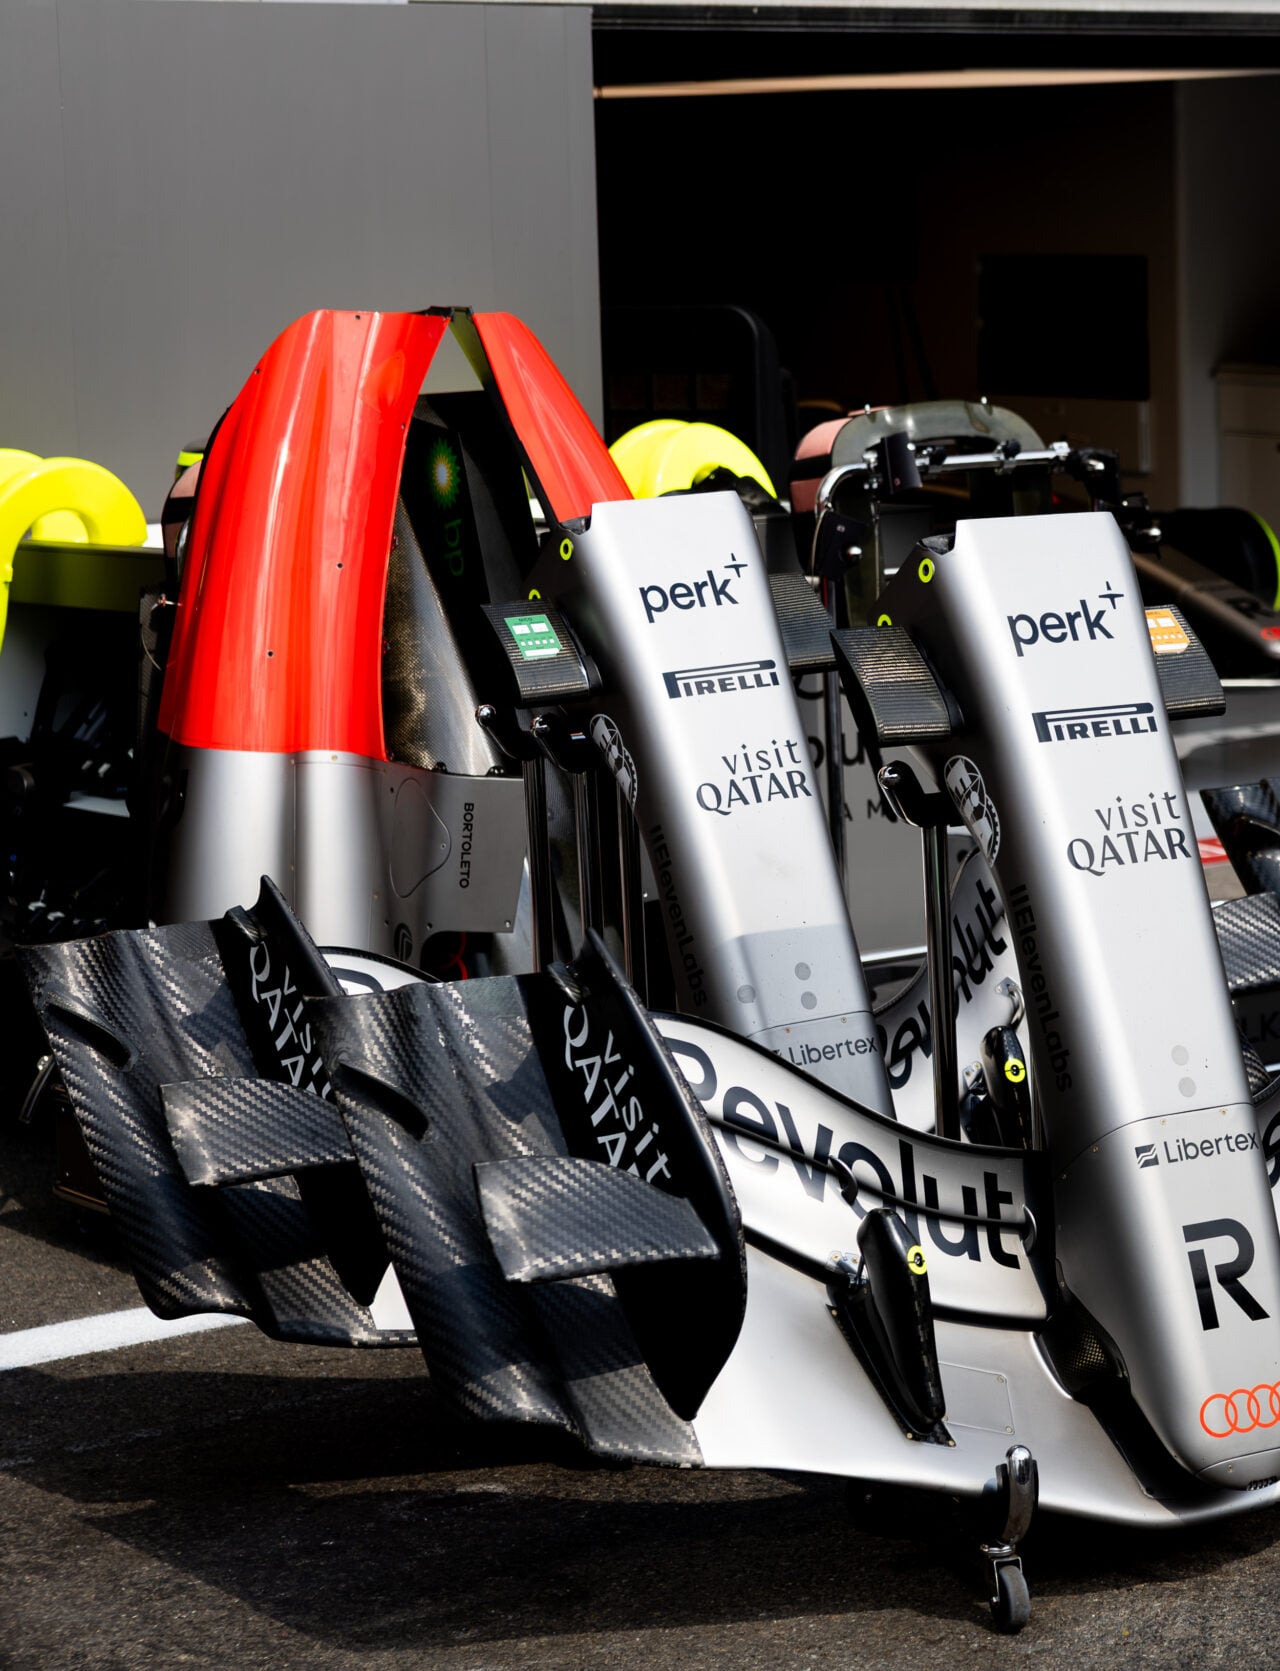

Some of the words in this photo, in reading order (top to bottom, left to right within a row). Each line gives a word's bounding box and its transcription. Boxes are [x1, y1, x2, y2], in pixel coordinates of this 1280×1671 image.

[662, 659, 780, 699] PIRELLI
[1032, 702, 1158, 743] PIRELLI
[721, 739, 802, 775] visit
[696, 770, 812, 816] QATAR
[1095, 792, 1181, 831] visit
[459, 802, 475, 889] BORTOLETO
[1067, 828, 1192, 877] QATAR
[250, 941, 318, 1095] QATA
[788, 1036, 878, 1067] Libertex
[563, 1004, 640, 1177] QATA
[604, 1029, 672, 1184] visit
[1163, 1132, 1260, 1164] Libertex
[1182, 1217, 1271, 1331] R
